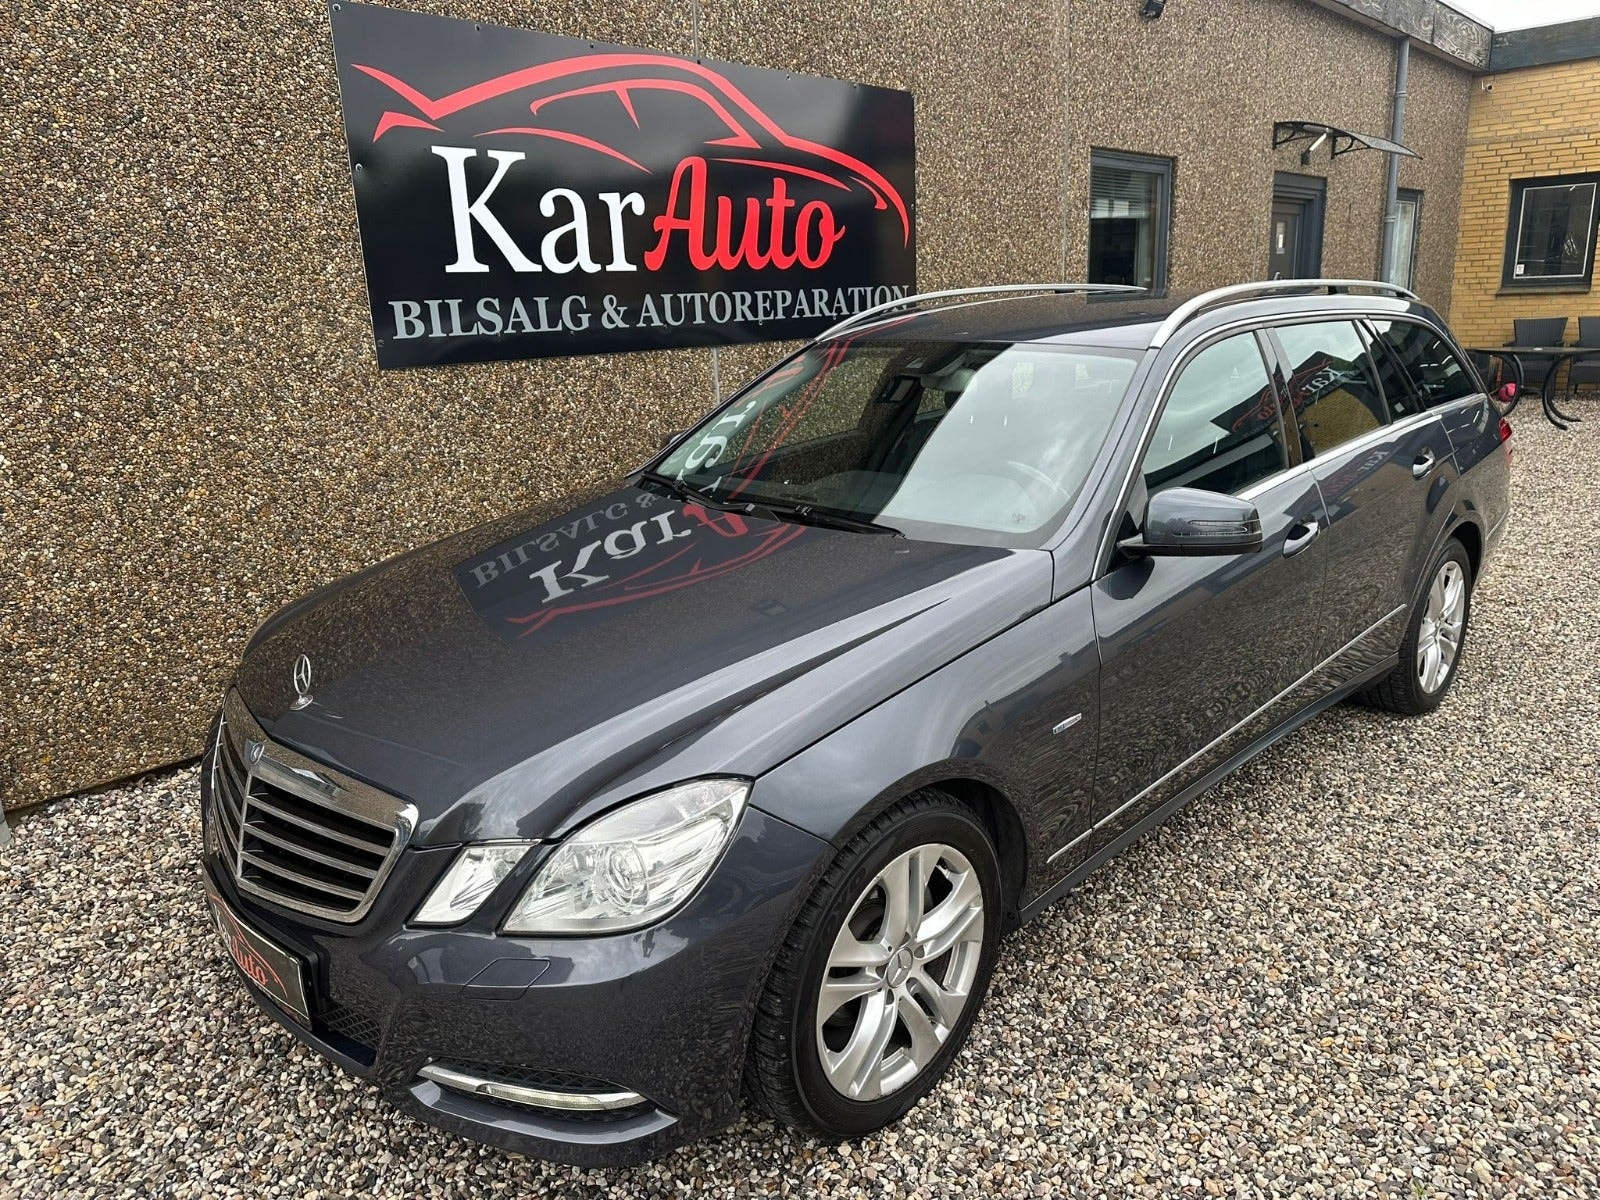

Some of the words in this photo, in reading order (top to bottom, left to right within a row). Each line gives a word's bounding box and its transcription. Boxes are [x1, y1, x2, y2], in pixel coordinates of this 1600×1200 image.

[388, 295, 591, 340] BILSALG
[601, 295, 631, 330] &
[636, 285, 909, 328] AUTOREPARATION
